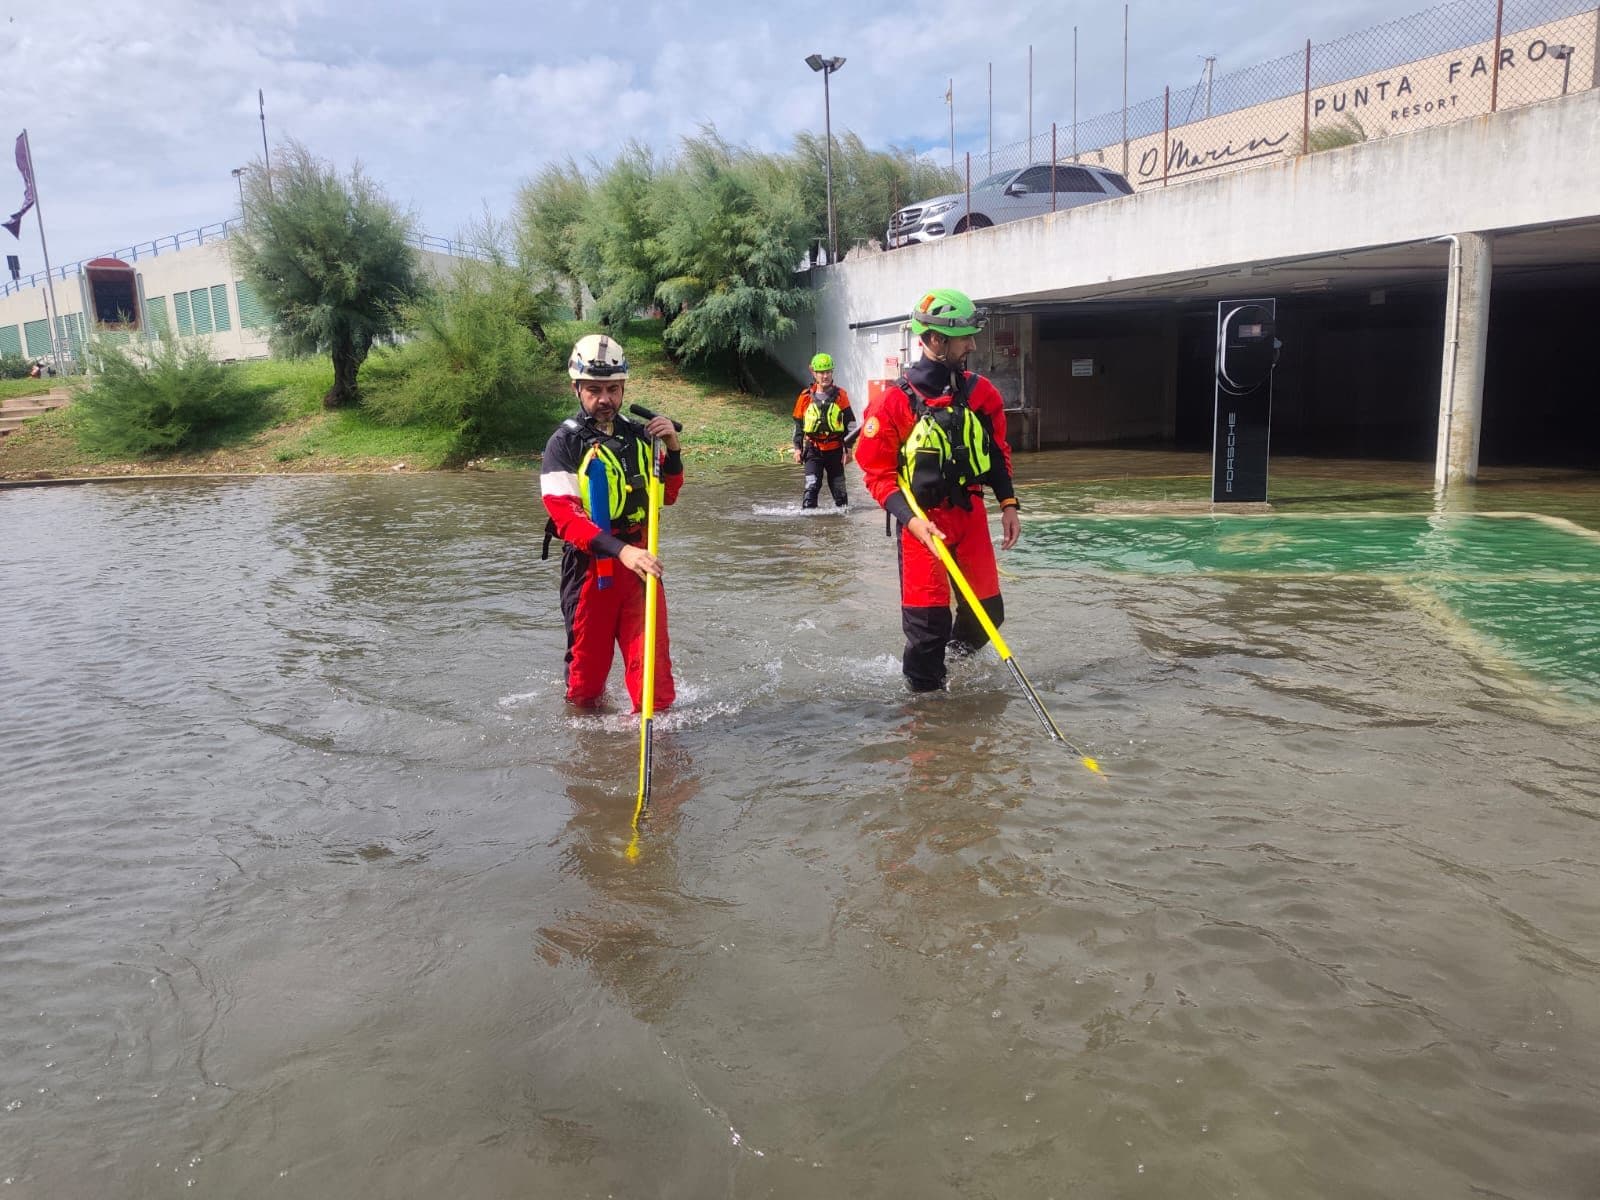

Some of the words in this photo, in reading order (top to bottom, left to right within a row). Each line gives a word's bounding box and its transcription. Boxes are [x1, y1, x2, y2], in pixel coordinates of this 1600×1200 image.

[1314, 76, 1412, 117] PUNTA
[1448, 39, 1548, 83] FARO
[1391, 95, 1458, 120] RESORT
[1166, 131, 1290, 172] Marin
[1225, 411, 1237, 493] PORSCHE
